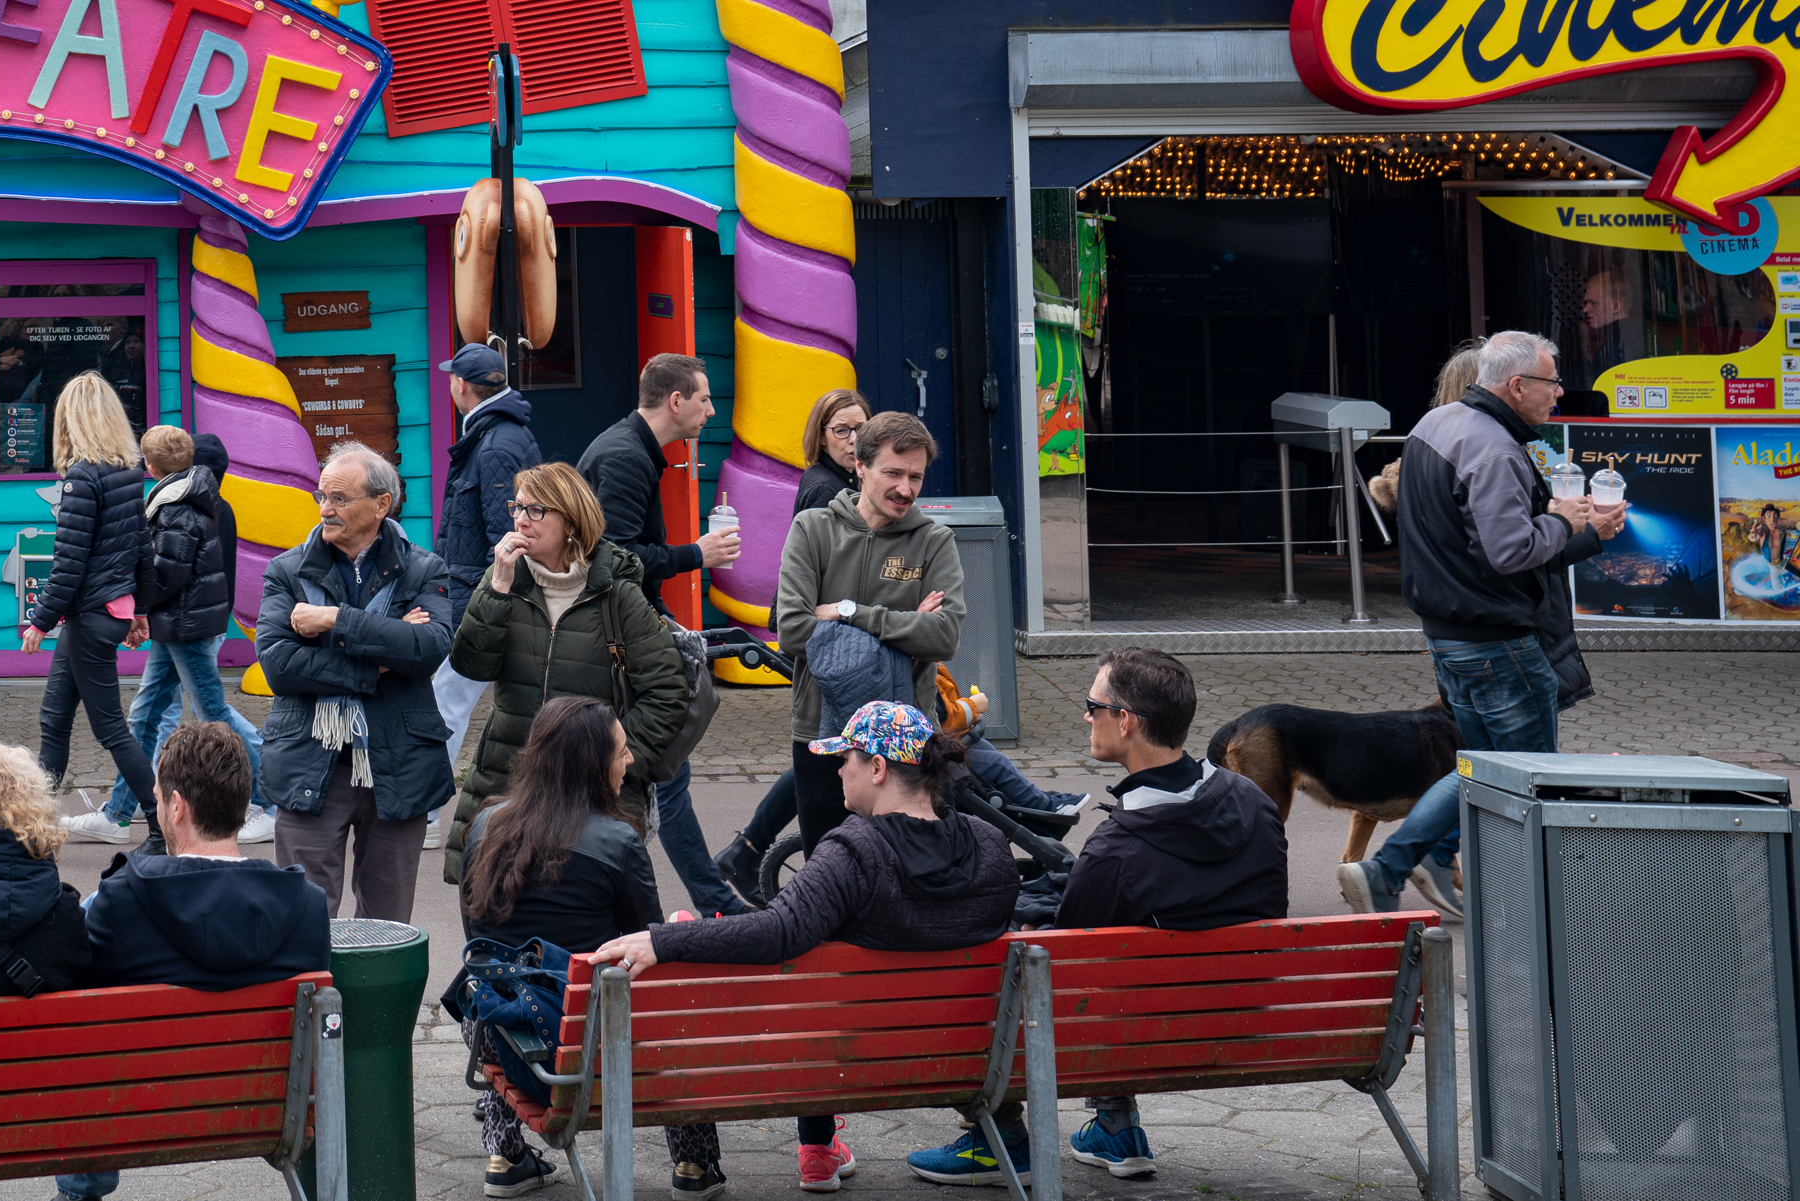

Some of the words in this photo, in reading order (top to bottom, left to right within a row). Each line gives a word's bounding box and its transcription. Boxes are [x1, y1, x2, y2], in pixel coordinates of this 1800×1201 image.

[1699, 237, 1761, 255] CINEMA
[297, 302, 360, 318] UDGANG
[29, 334, 41, 342] DIG
[42, 334, 58, 342] SELV
[1729, 395, 1736, 405] 5
[1737, 395, 1756, 405] min
[315, 423, 334, 437] Sådan
[1581, 451, 1630, 464] SKY
[1635, 452, 1703, 466] HUNT
[1732, 441, 1800, 466] Alad
[1644, 466, 1667, 474] THE
[1669, 467, 1696, 475] RIDE
[1778, 467, 1793, 476] THE
[887, 558, 902, 567] THE
